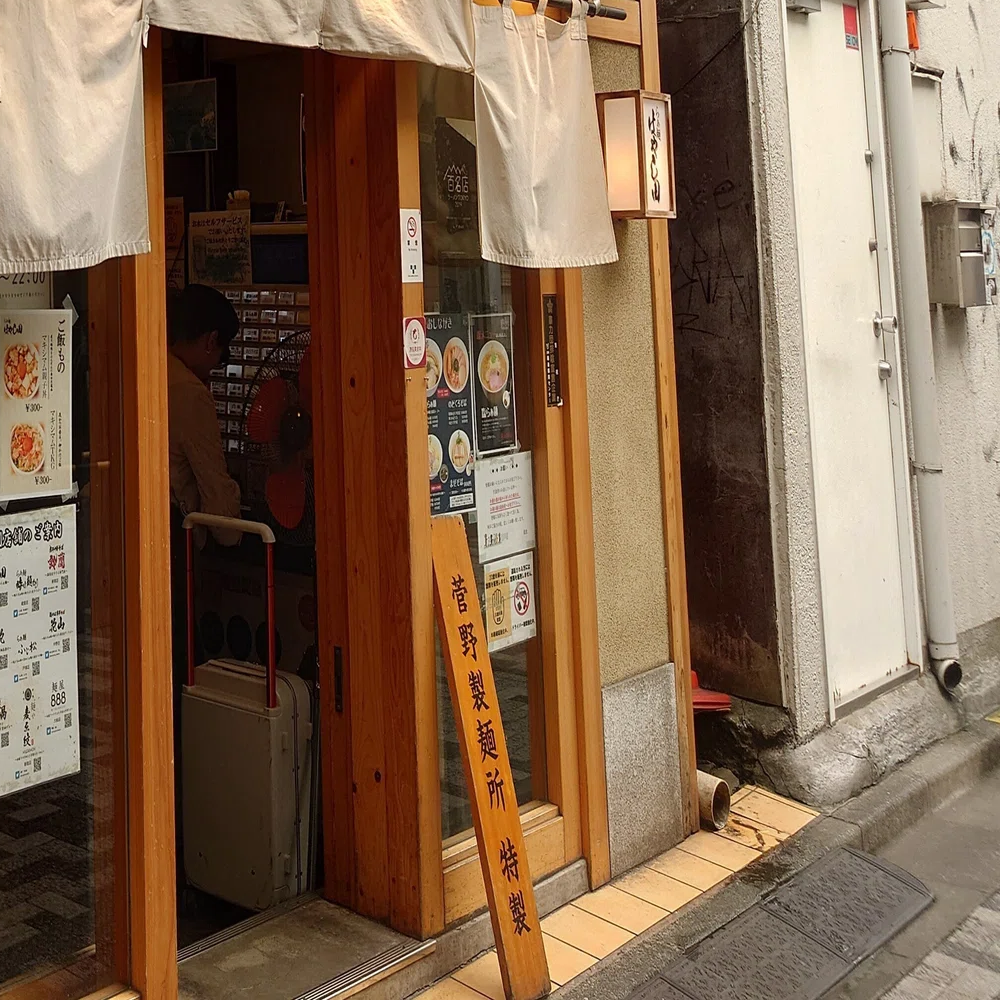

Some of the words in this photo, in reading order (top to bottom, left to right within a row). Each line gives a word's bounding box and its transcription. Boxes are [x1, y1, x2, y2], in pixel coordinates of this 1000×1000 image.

[56, 319, 66, 374] ご飯もの
[50, 691, 67, 708] 888
[450, 574, 505, 811] 菅野製麺所
[499, 837, 531, 936] 特製
